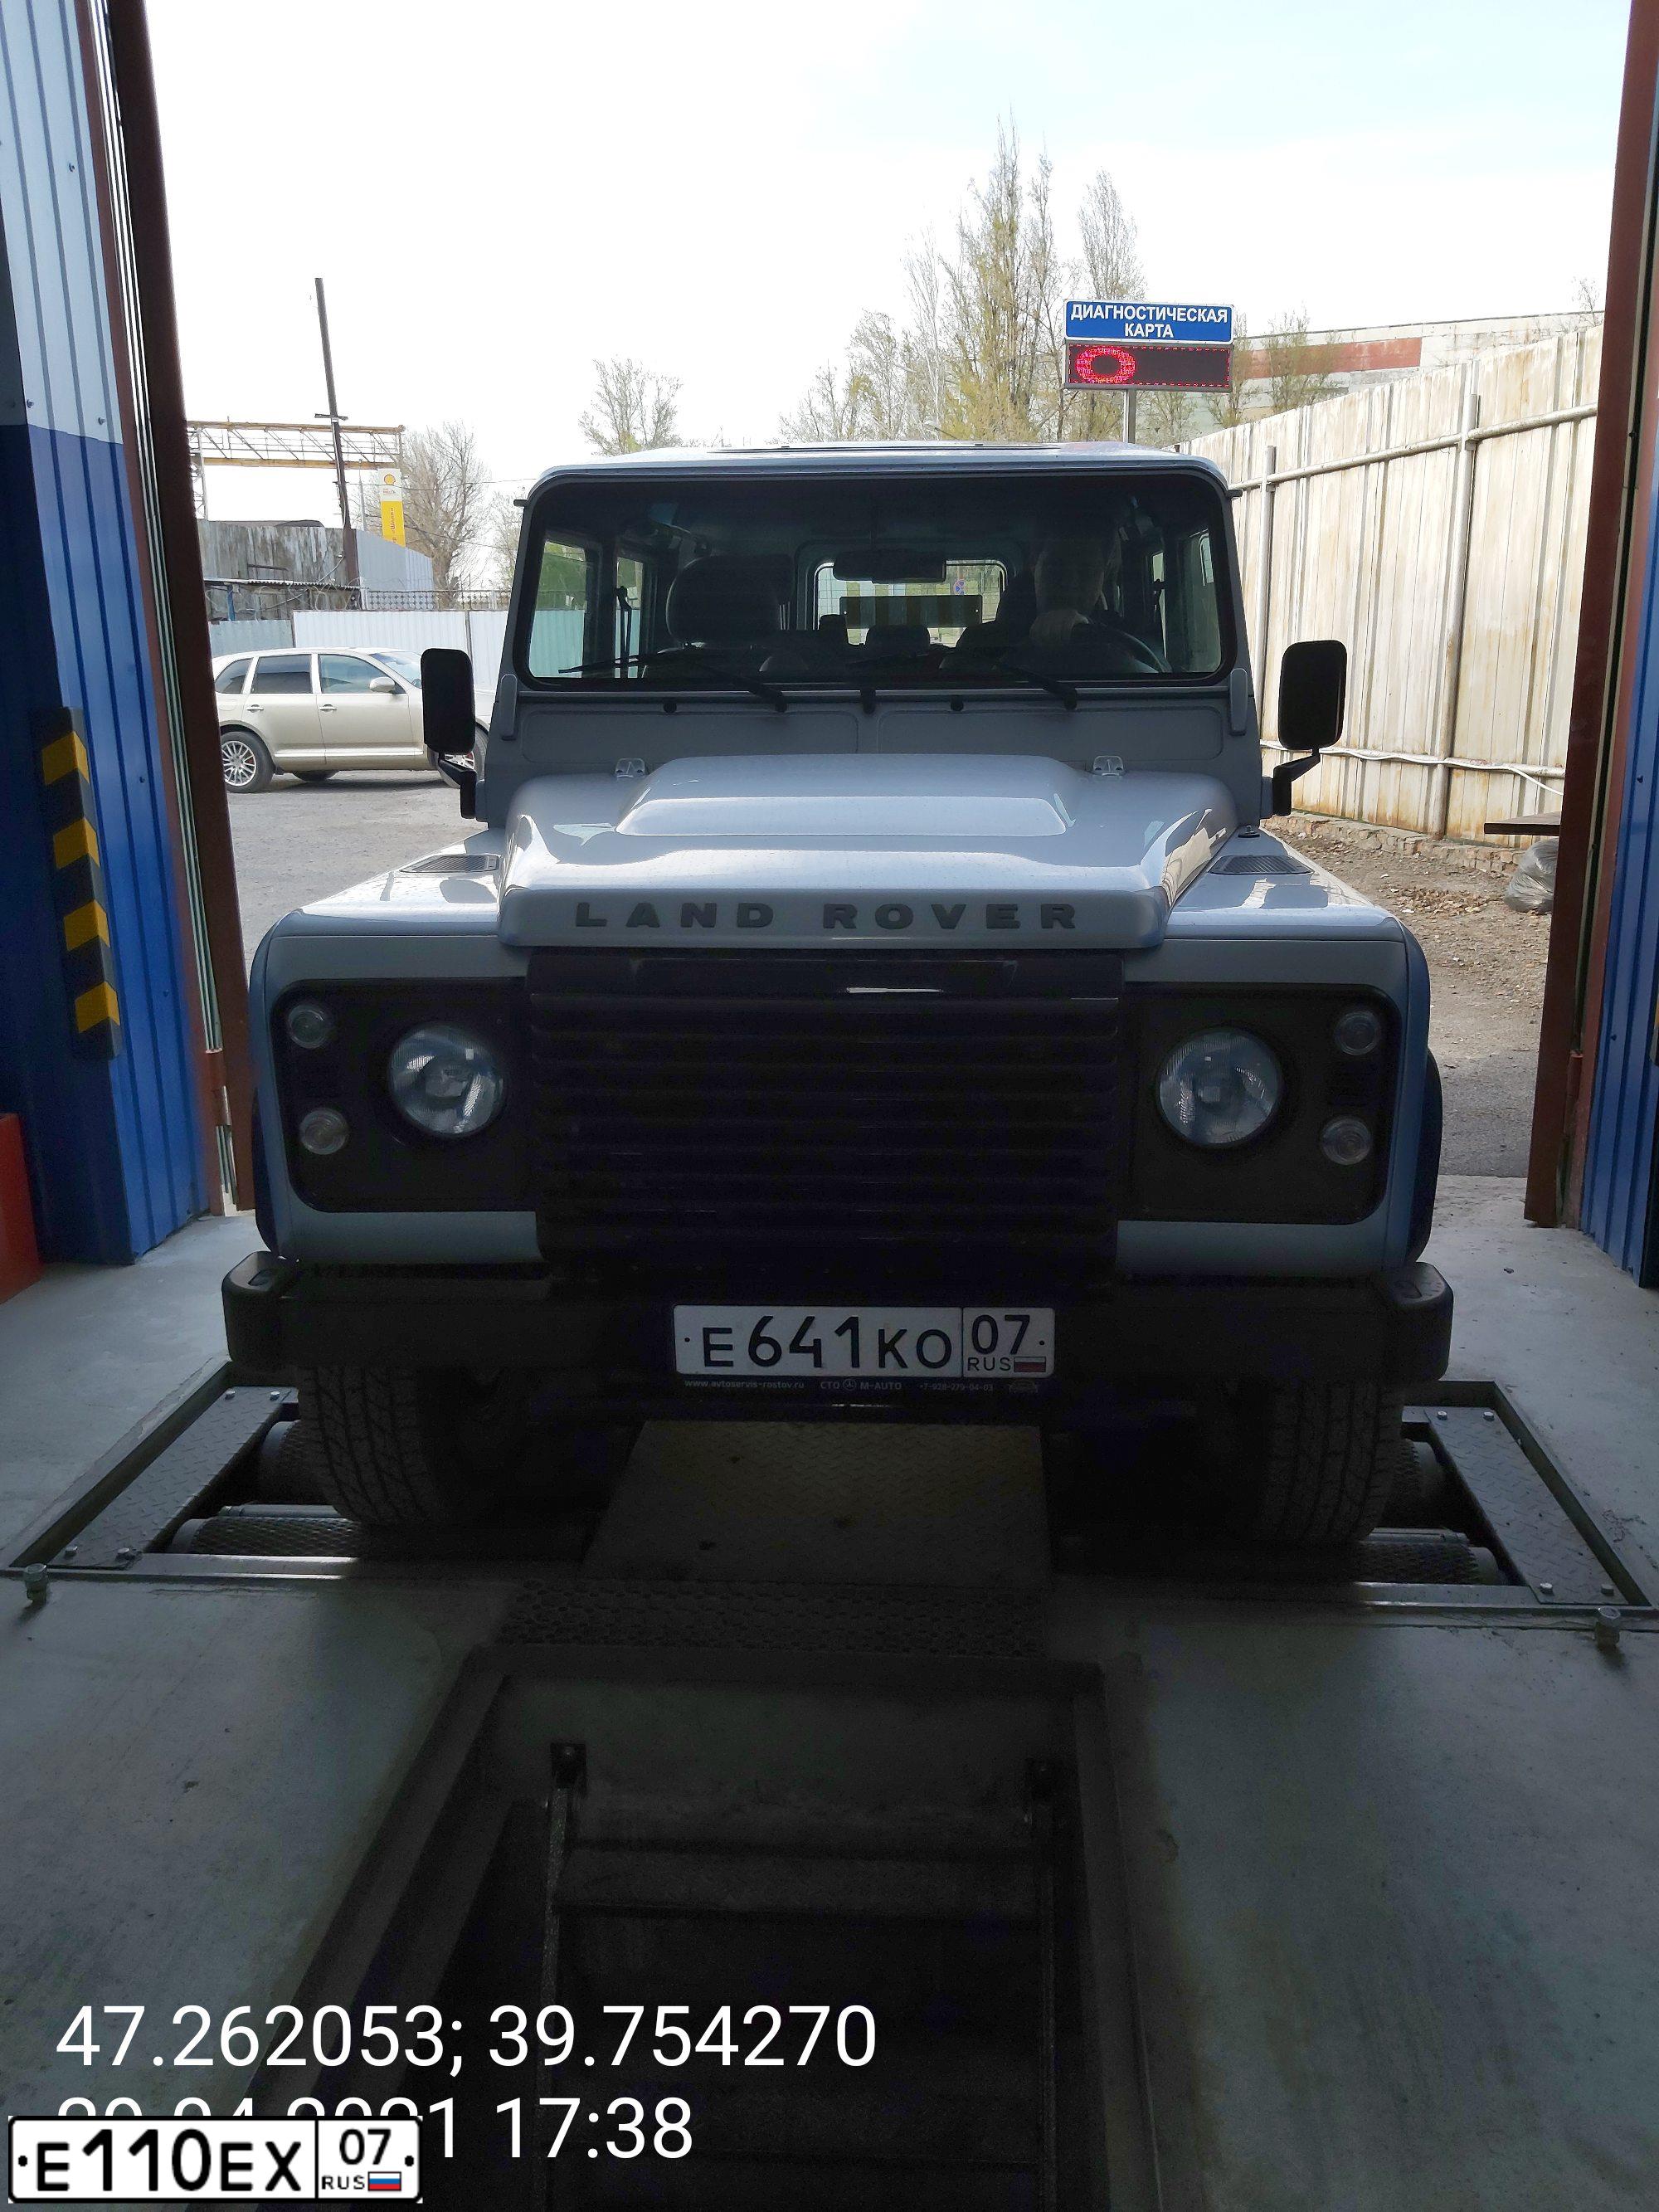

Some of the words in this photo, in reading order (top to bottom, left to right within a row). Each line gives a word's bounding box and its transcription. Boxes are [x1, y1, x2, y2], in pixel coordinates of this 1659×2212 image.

[1070, 304, 1228, 324] ДИАГНОСТИЧЕСКАЯ
[1124, 323, 1175, 339] КАРТА
[574, 902, 774, 928] LAND
[822, 903, 1076, 930] ROVER
[971, 1314, 1031, 1355] 07
[966, 1357, 1011, 1372] RUS
[684, 1380, 805, 1390] www.avtoservis-rostov.ru
[859, 1381, 902, 1391] M-AUTO
